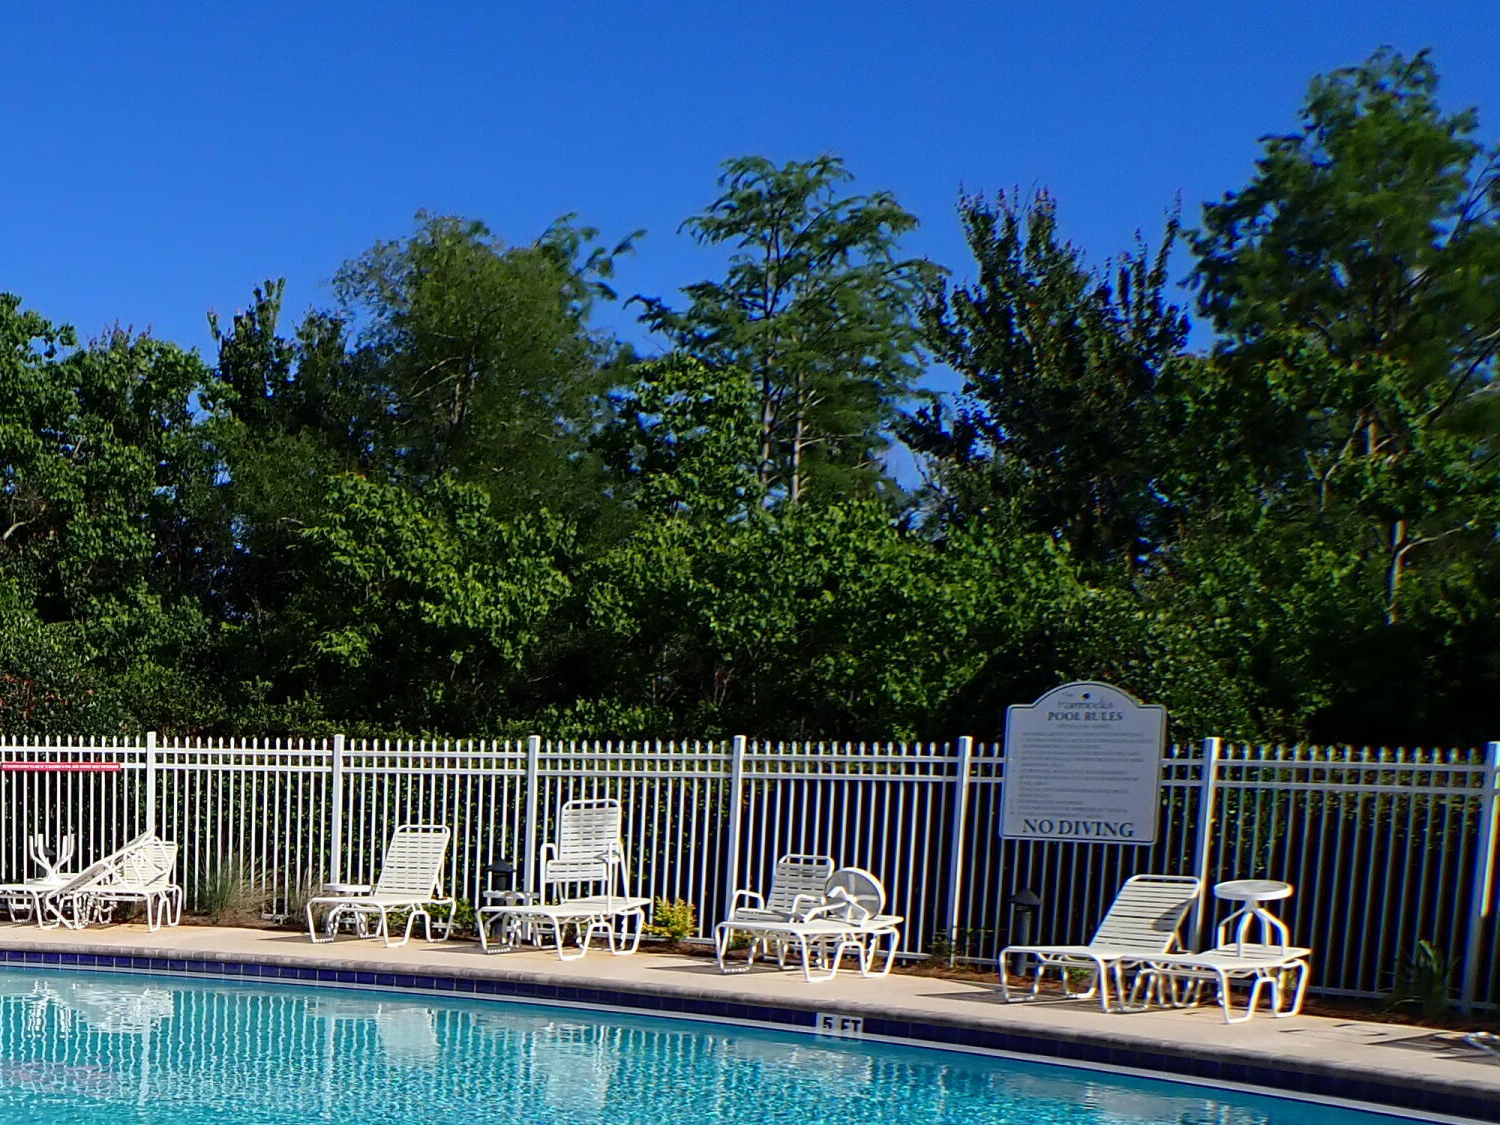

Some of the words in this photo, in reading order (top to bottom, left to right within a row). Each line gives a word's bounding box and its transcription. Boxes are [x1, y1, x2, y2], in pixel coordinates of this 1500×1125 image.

[1047, 711, 1081, 721] POOL
[1084, 711, 1124, 721] RULES
[1022, 818, 1053, 835] NO
[1058, 819, 1135, 838] DIVING
[822, 1016, 833, 1029] 5
